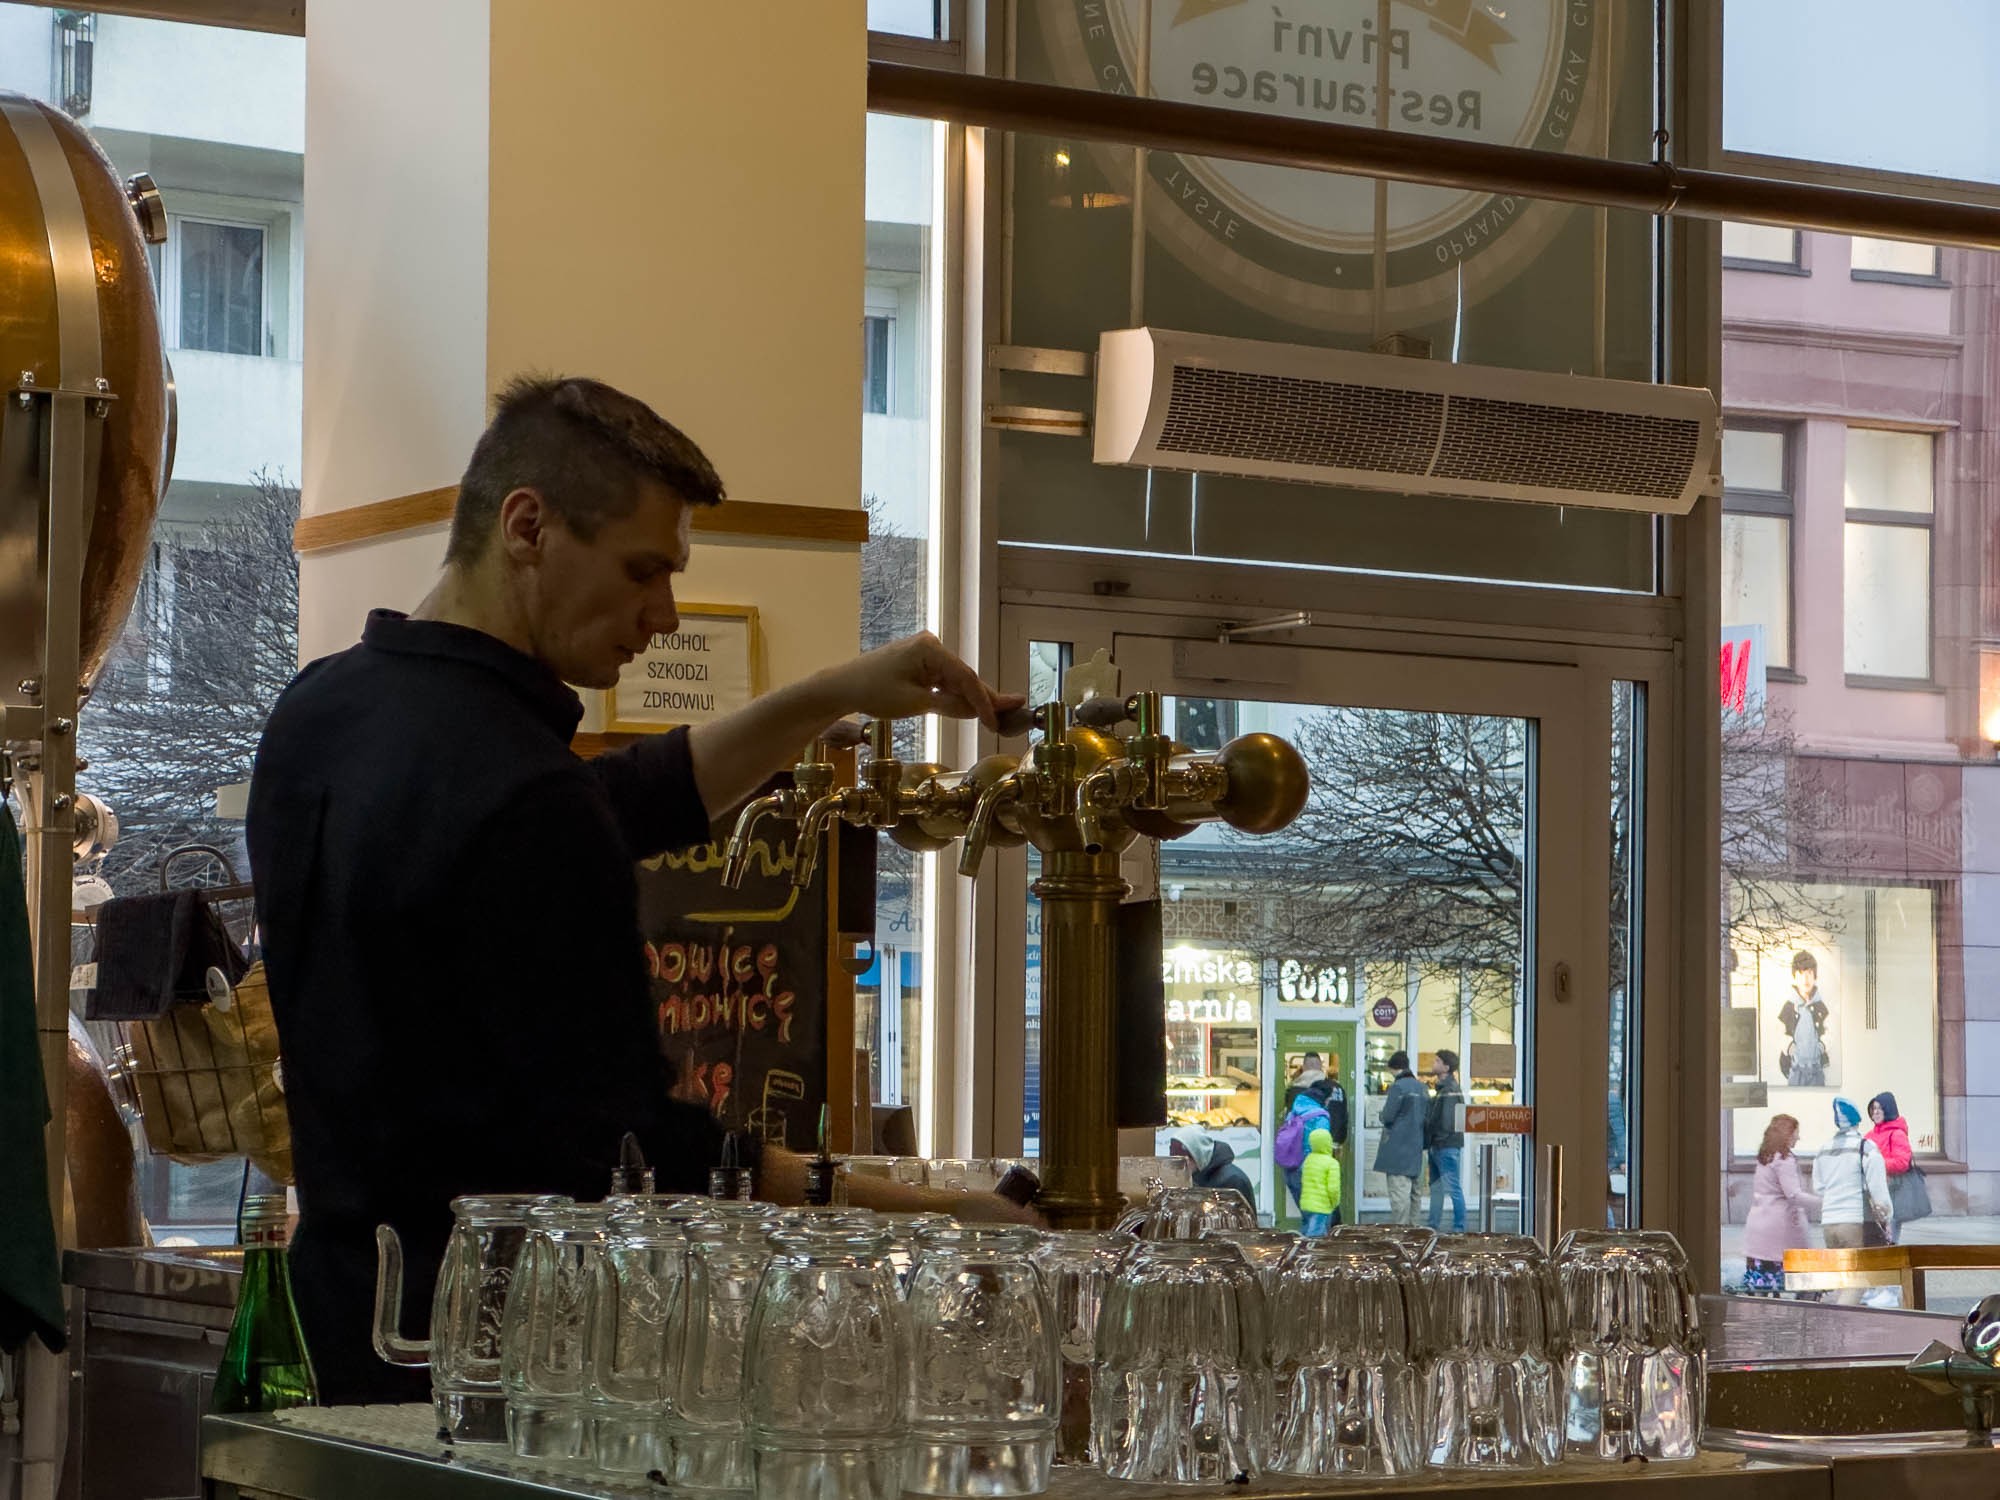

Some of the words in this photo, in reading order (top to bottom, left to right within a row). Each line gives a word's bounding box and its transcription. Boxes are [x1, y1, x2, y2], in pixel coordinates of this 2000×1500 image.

[646, 660, 709, 682] SZKODZI
[642, 689, 716, 712] ZDROWIU!
[1167, 991, 1253, 1023] arnia
[1499, 1121, 1519, 1130] PULL
